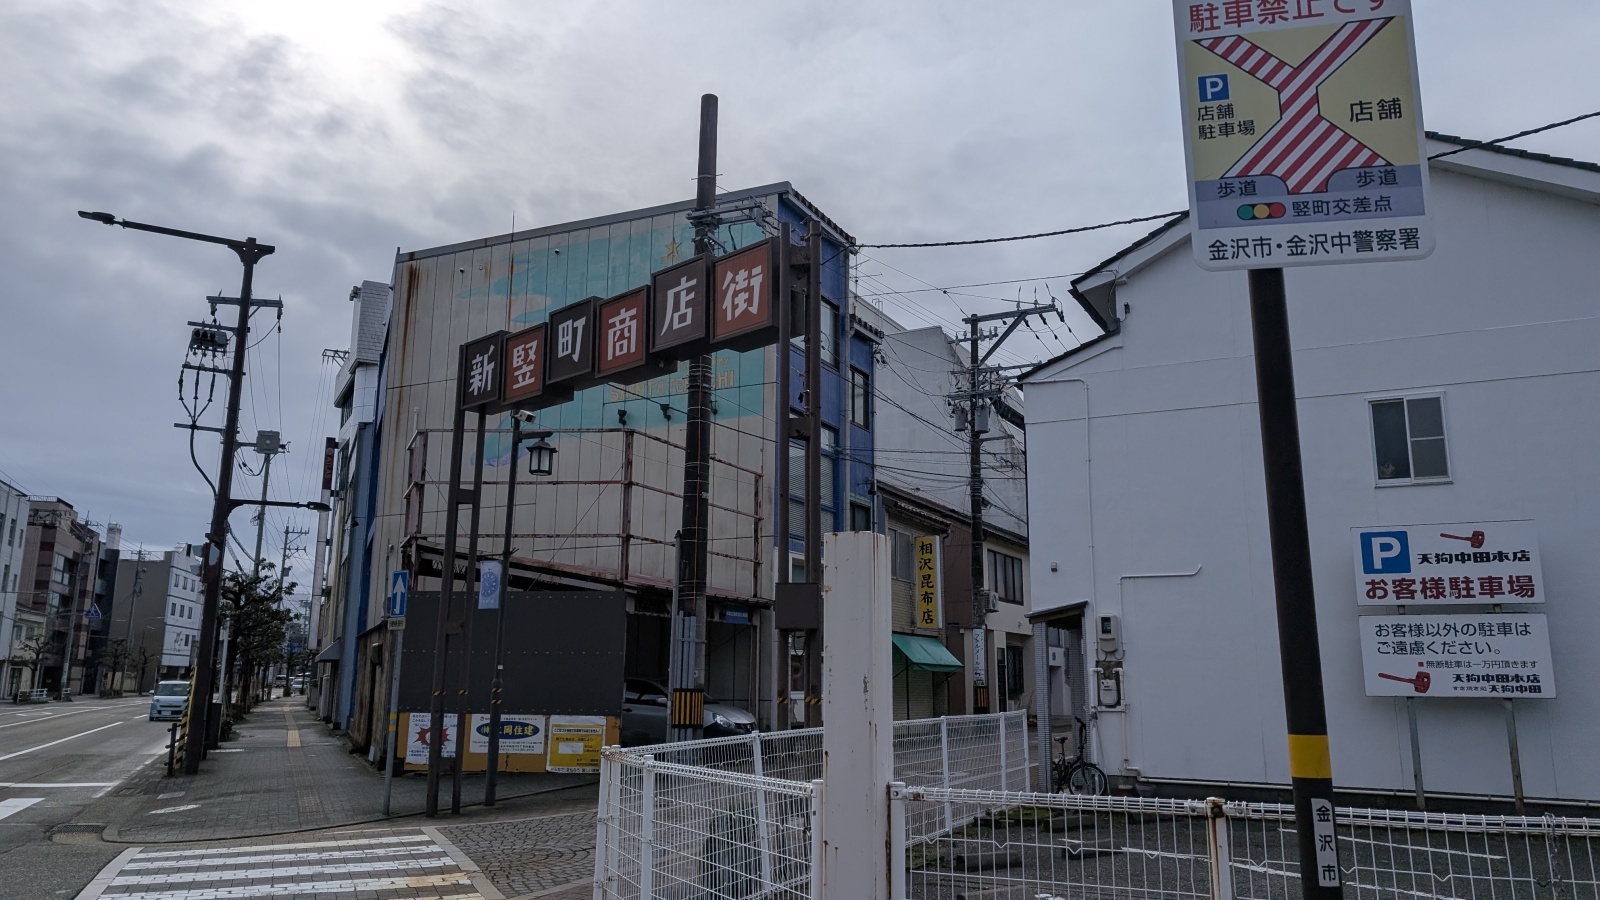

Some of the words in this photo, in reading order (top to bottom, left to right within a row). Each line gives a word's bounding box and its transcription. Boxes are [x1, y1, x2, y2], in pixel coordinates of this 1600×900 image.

[1206, 77, 1224, 99] P
[1197, 103, 1235, 122] 店舗
[1349, 97, 1402, 122] 店舗
[1198, 119, 1255, 140] 駐車場
[1217, 179, 1257, 198] 歩道
[1356, 168, 1398, 188] 歩道
[1292, 196, 1392, 217] 竪町交差点
[1208, 228, 1420, 261] 金沢市・金沢中警察署
[469, 264, 764, 396] 新竪町商店街
[1371, 536, 1401, 570] P
[1417, 549, 1531, 565] 天狗中田本店
[918, 541, 935, 625] 相沢昆布店
[1365, 574, 1535, 601] お客様駐車場
[1374, 622, 1531, 638] お客様以外の駐車は
[1377, 641, 1501, 655] ご遠慮ください。
[1452, 673, 1541, 684] 天狗中田本店
[1488, 684, 1542, 694] 天狗中田
[1315, 804, 1337, 883] 金沢市
